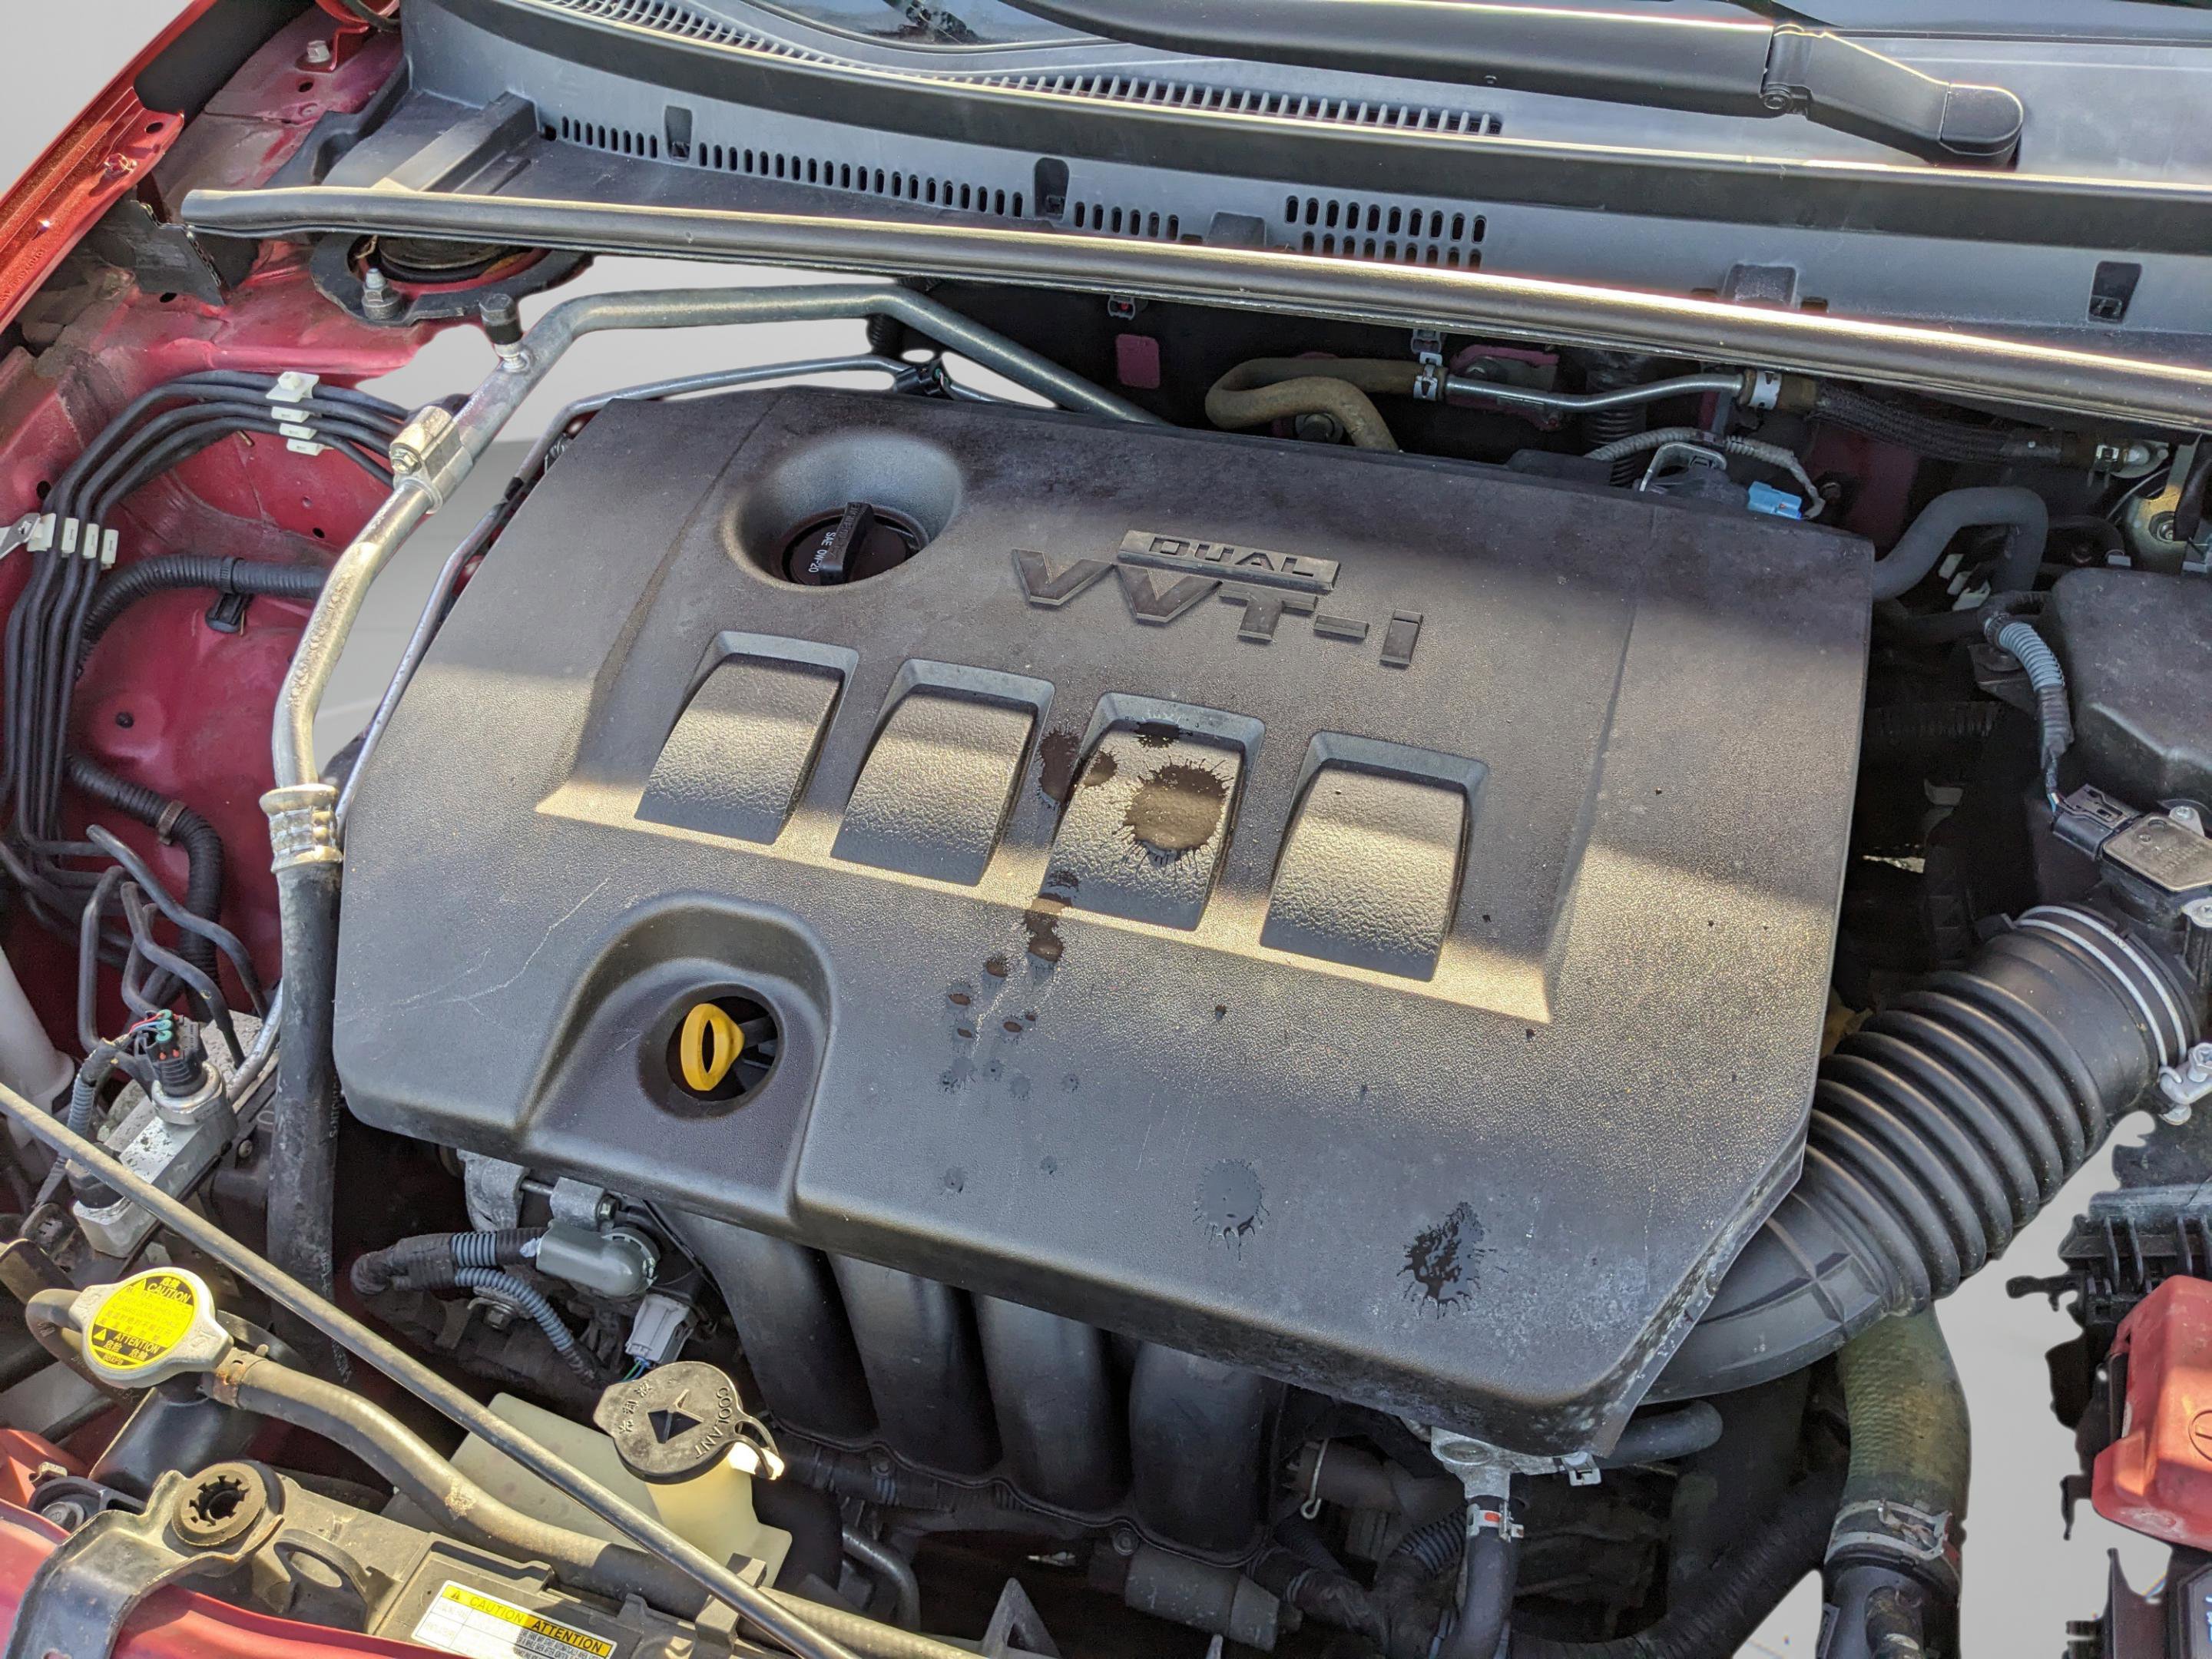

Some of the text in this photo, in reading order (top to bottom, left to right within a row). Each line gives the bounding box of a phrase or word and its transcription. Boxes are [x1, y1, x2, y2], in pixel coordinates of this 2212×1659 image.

[821, 531, 836, 546] SAE
[1146, 534, 1316, 579] DUAL
[147, 1283, 191, 1304] CAUTION
[113, 1332, 161, 1354] ATTENTION
[695, 1386, 733, 1459] COOLANT
[469, 1596, 525, 1624] CAUTION
[531, 1620, 603, 1653] ATTENTION
